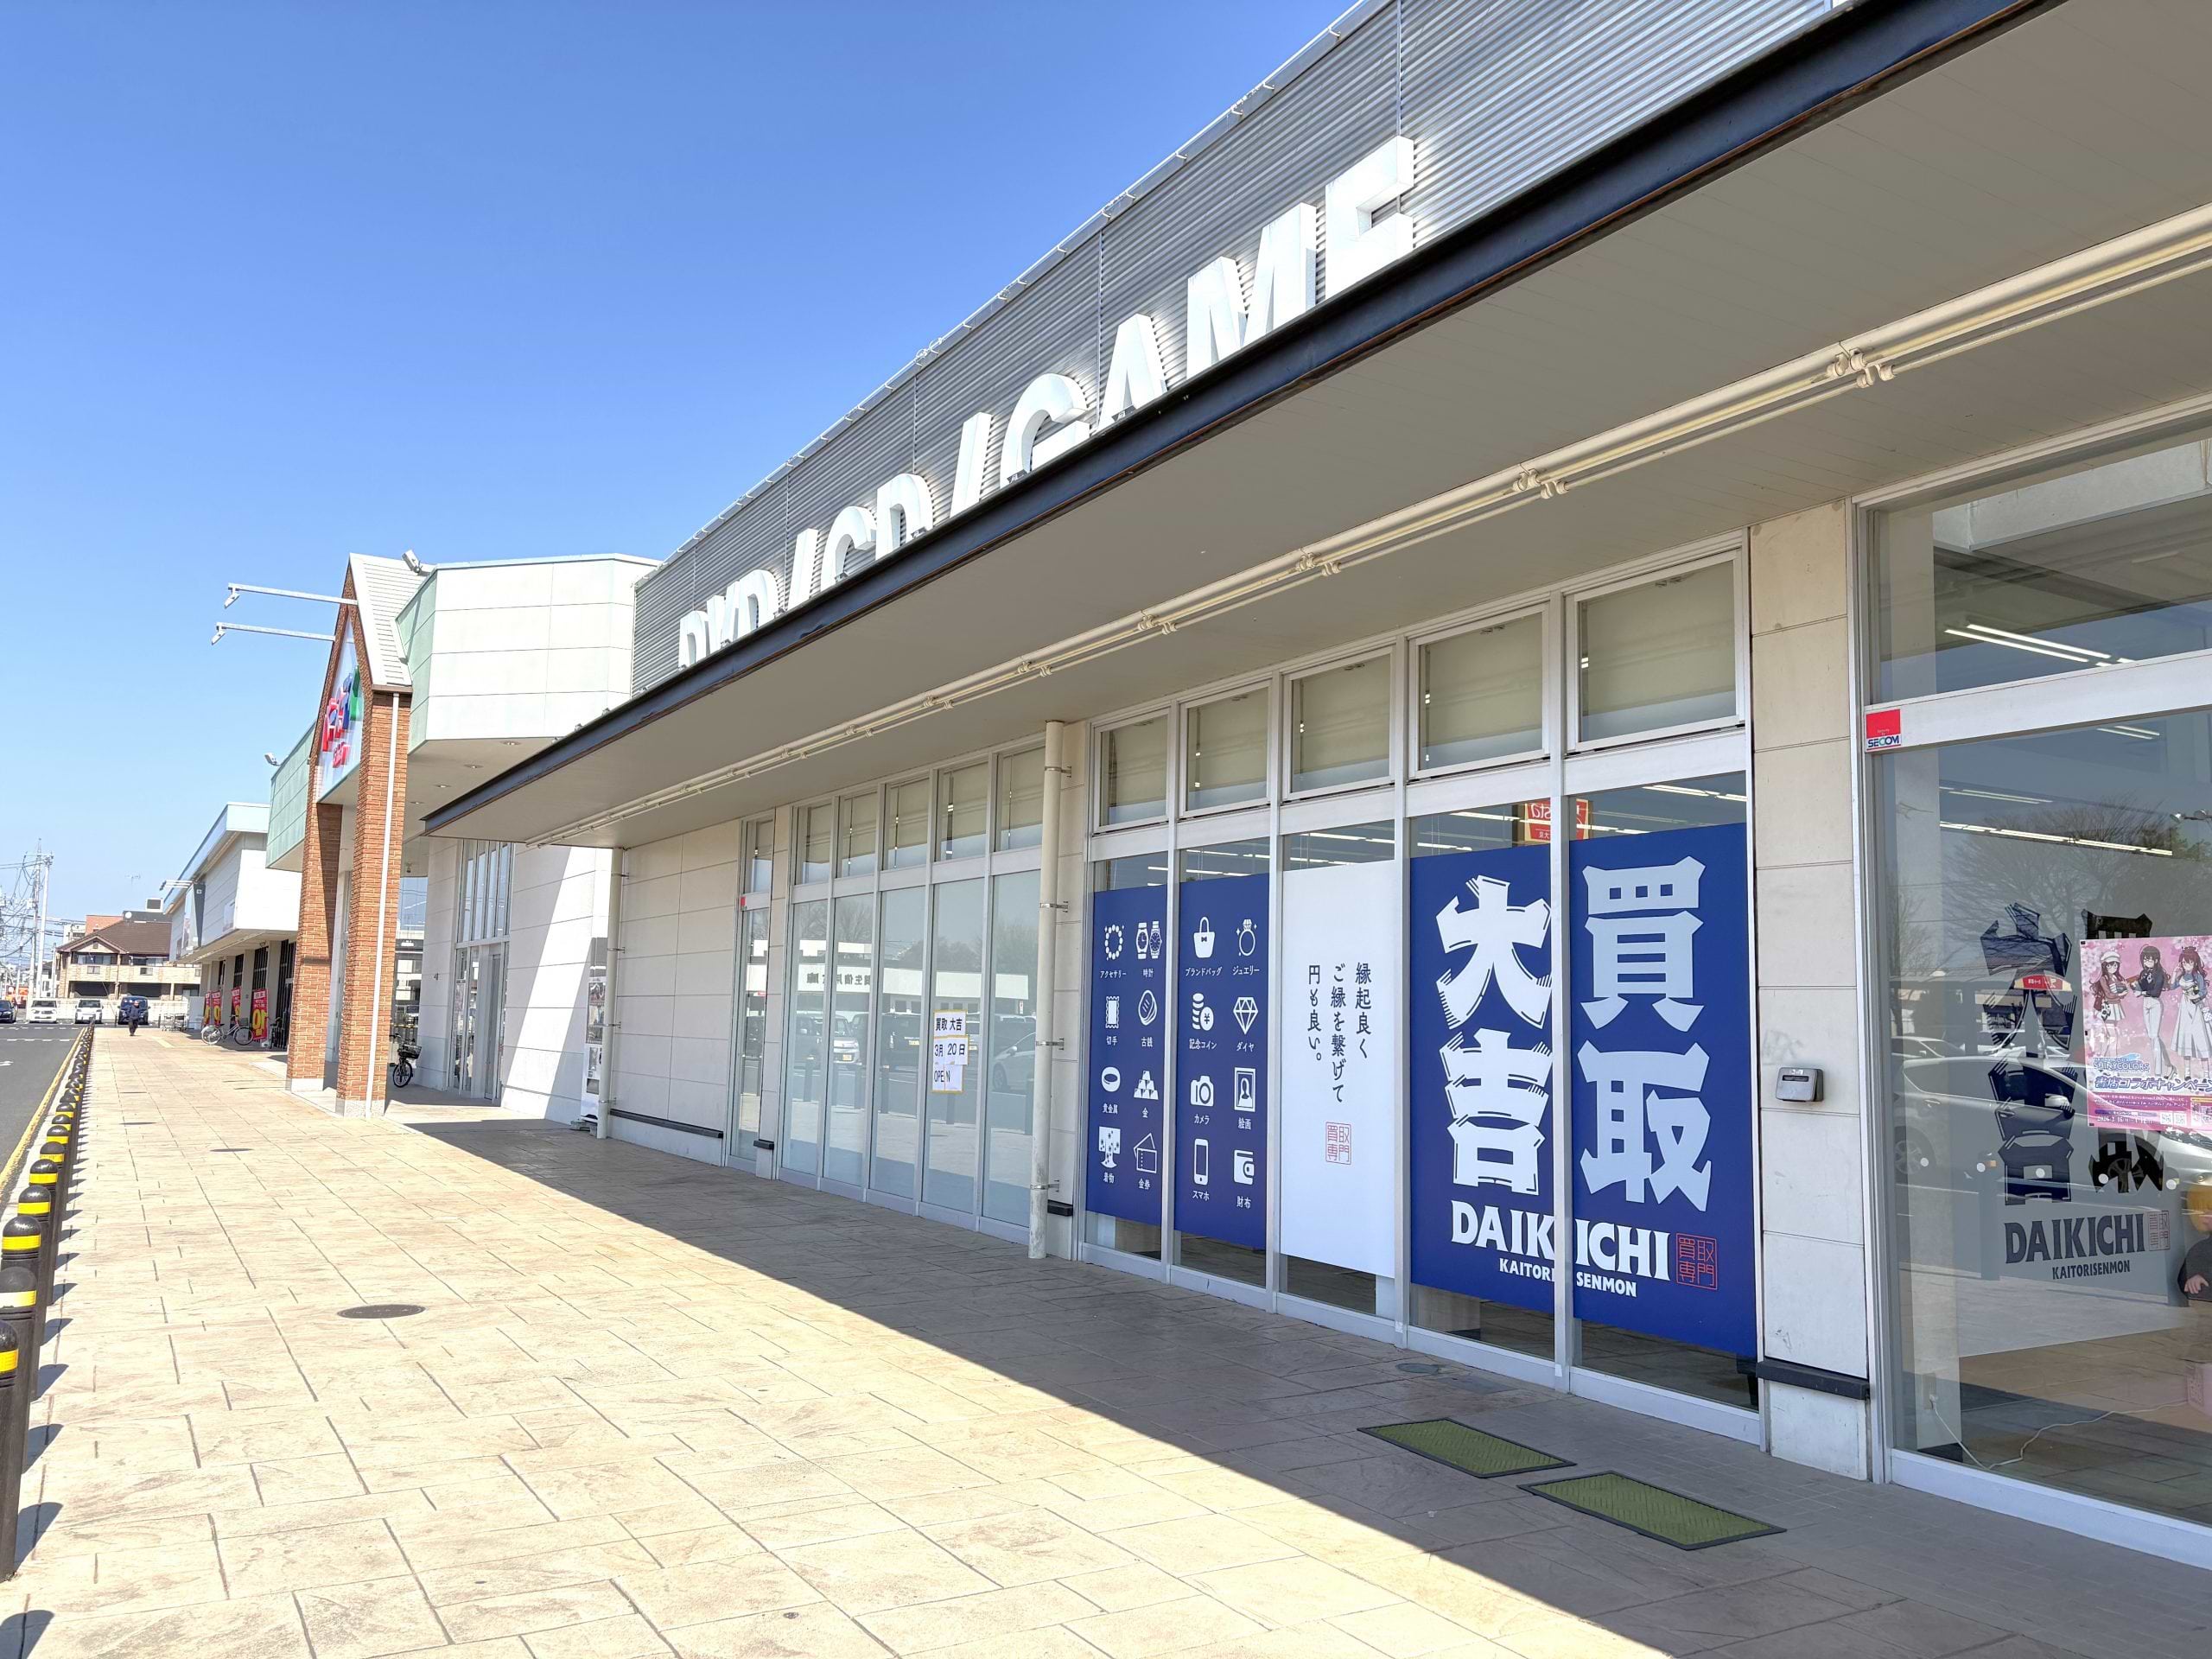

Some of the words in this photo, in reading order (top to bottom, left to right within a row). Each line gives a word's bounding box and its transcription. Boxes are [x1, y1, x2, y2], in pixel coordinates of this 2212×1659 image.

[1868, 735, 1899, 747] SECOM
[1100, 969, 1127, 979] アクセサリー
[1142, 968, 1154, 978] 時計
[1185, 966, 1223, 976] ブランドバッグ
[1232, 965, 1260, 976] ジュエリー
[1307, 964, 1322, 1061] 円も良い。
[1355, 962, 1372, 1058] 縁起良く
[936, 1018, 947, 1031] 買取
[950, 1018, 962, 1031] 大吉
[1330, 963, 1347, 1103] ご縁を繋げて
[1436, 874, 1554, 1196] 大吉
[1578, 856, 1712, 1211] 買取
[1189, 1038, 1217, 1050] 記念コイン
[1236, 1041, 1255, 1052] ダイヤ
[2094, 1062, 2150, 1071] SHINYCOLORS
[1142, 1107, 1148, 1118] 金
[1194, 1113, 1210, 1125] カメラ
[1237, 1117, 1251, 1130] 絵画
[1192, 1190, 1210, 1202] スマホ
[1236, 1195, 1252, 1209] 財布
[1452, 1199, 1671, 1281] DAIKICHI
[2005, 1213, 2145, 1264] DAIKICHI
[2052, 1260, 2131, 1280] KAITORISENMON
